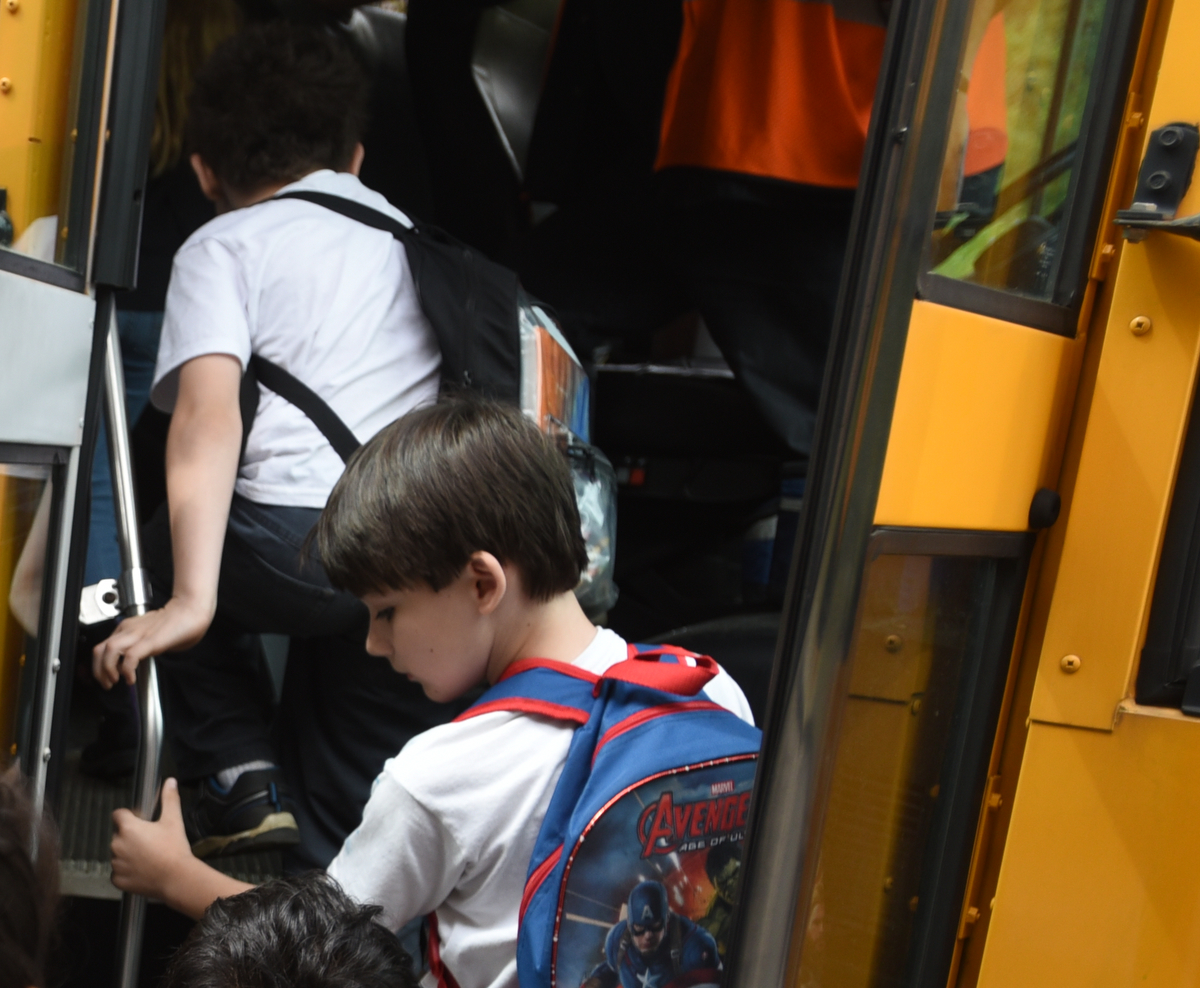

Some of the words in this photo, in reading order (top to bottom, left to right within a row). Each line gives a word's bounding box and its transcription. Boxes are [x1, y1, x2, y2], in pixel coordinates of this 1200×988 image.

[711, 780, 735, 795] MARVEL
[679, 841, 706, 853] AGE
[710, 837, 727, 847] OF
